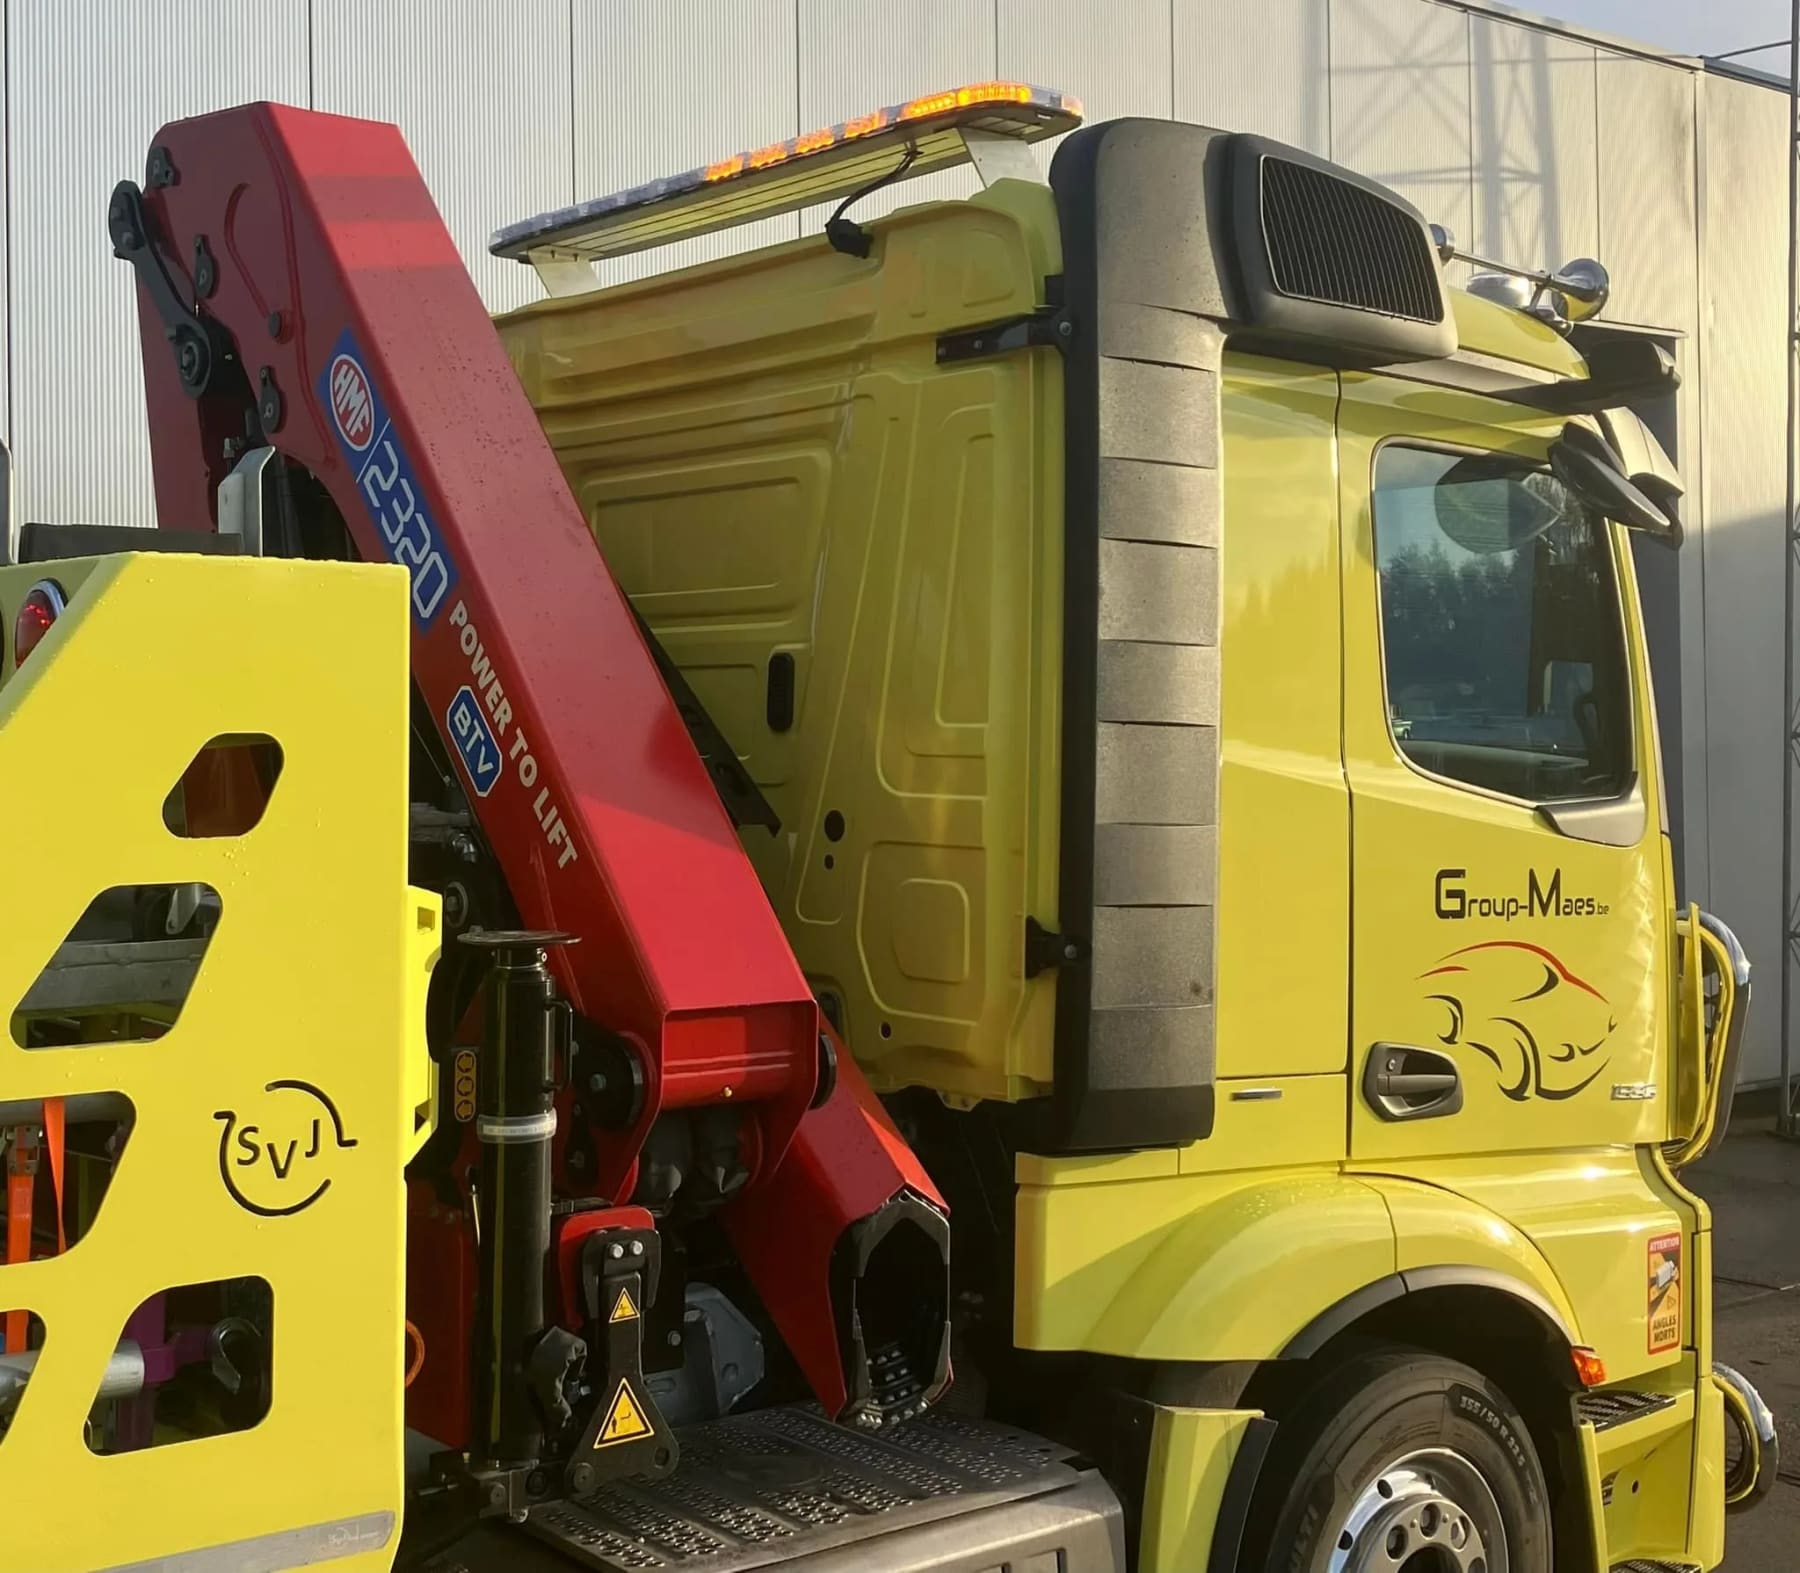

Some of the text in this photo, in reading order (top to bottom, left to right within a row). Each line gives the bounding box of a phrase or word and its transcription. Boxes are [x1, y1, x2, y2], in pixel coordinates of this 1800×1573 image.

[334, 364, 370, 438] HMF
[363, 441, 448, 618] 2320
[449, 600, 578, 869] POWER TO LIFT
[453, 702, 494, 774] BTV
[236, 1119, 320, 1179] SVJ
[1649, 1236, 1680, 1252] ATTENTION
[1653, 1315, 1676, 1330] ANGLES
[1653, 1328, 1676, 1343] MORTS
